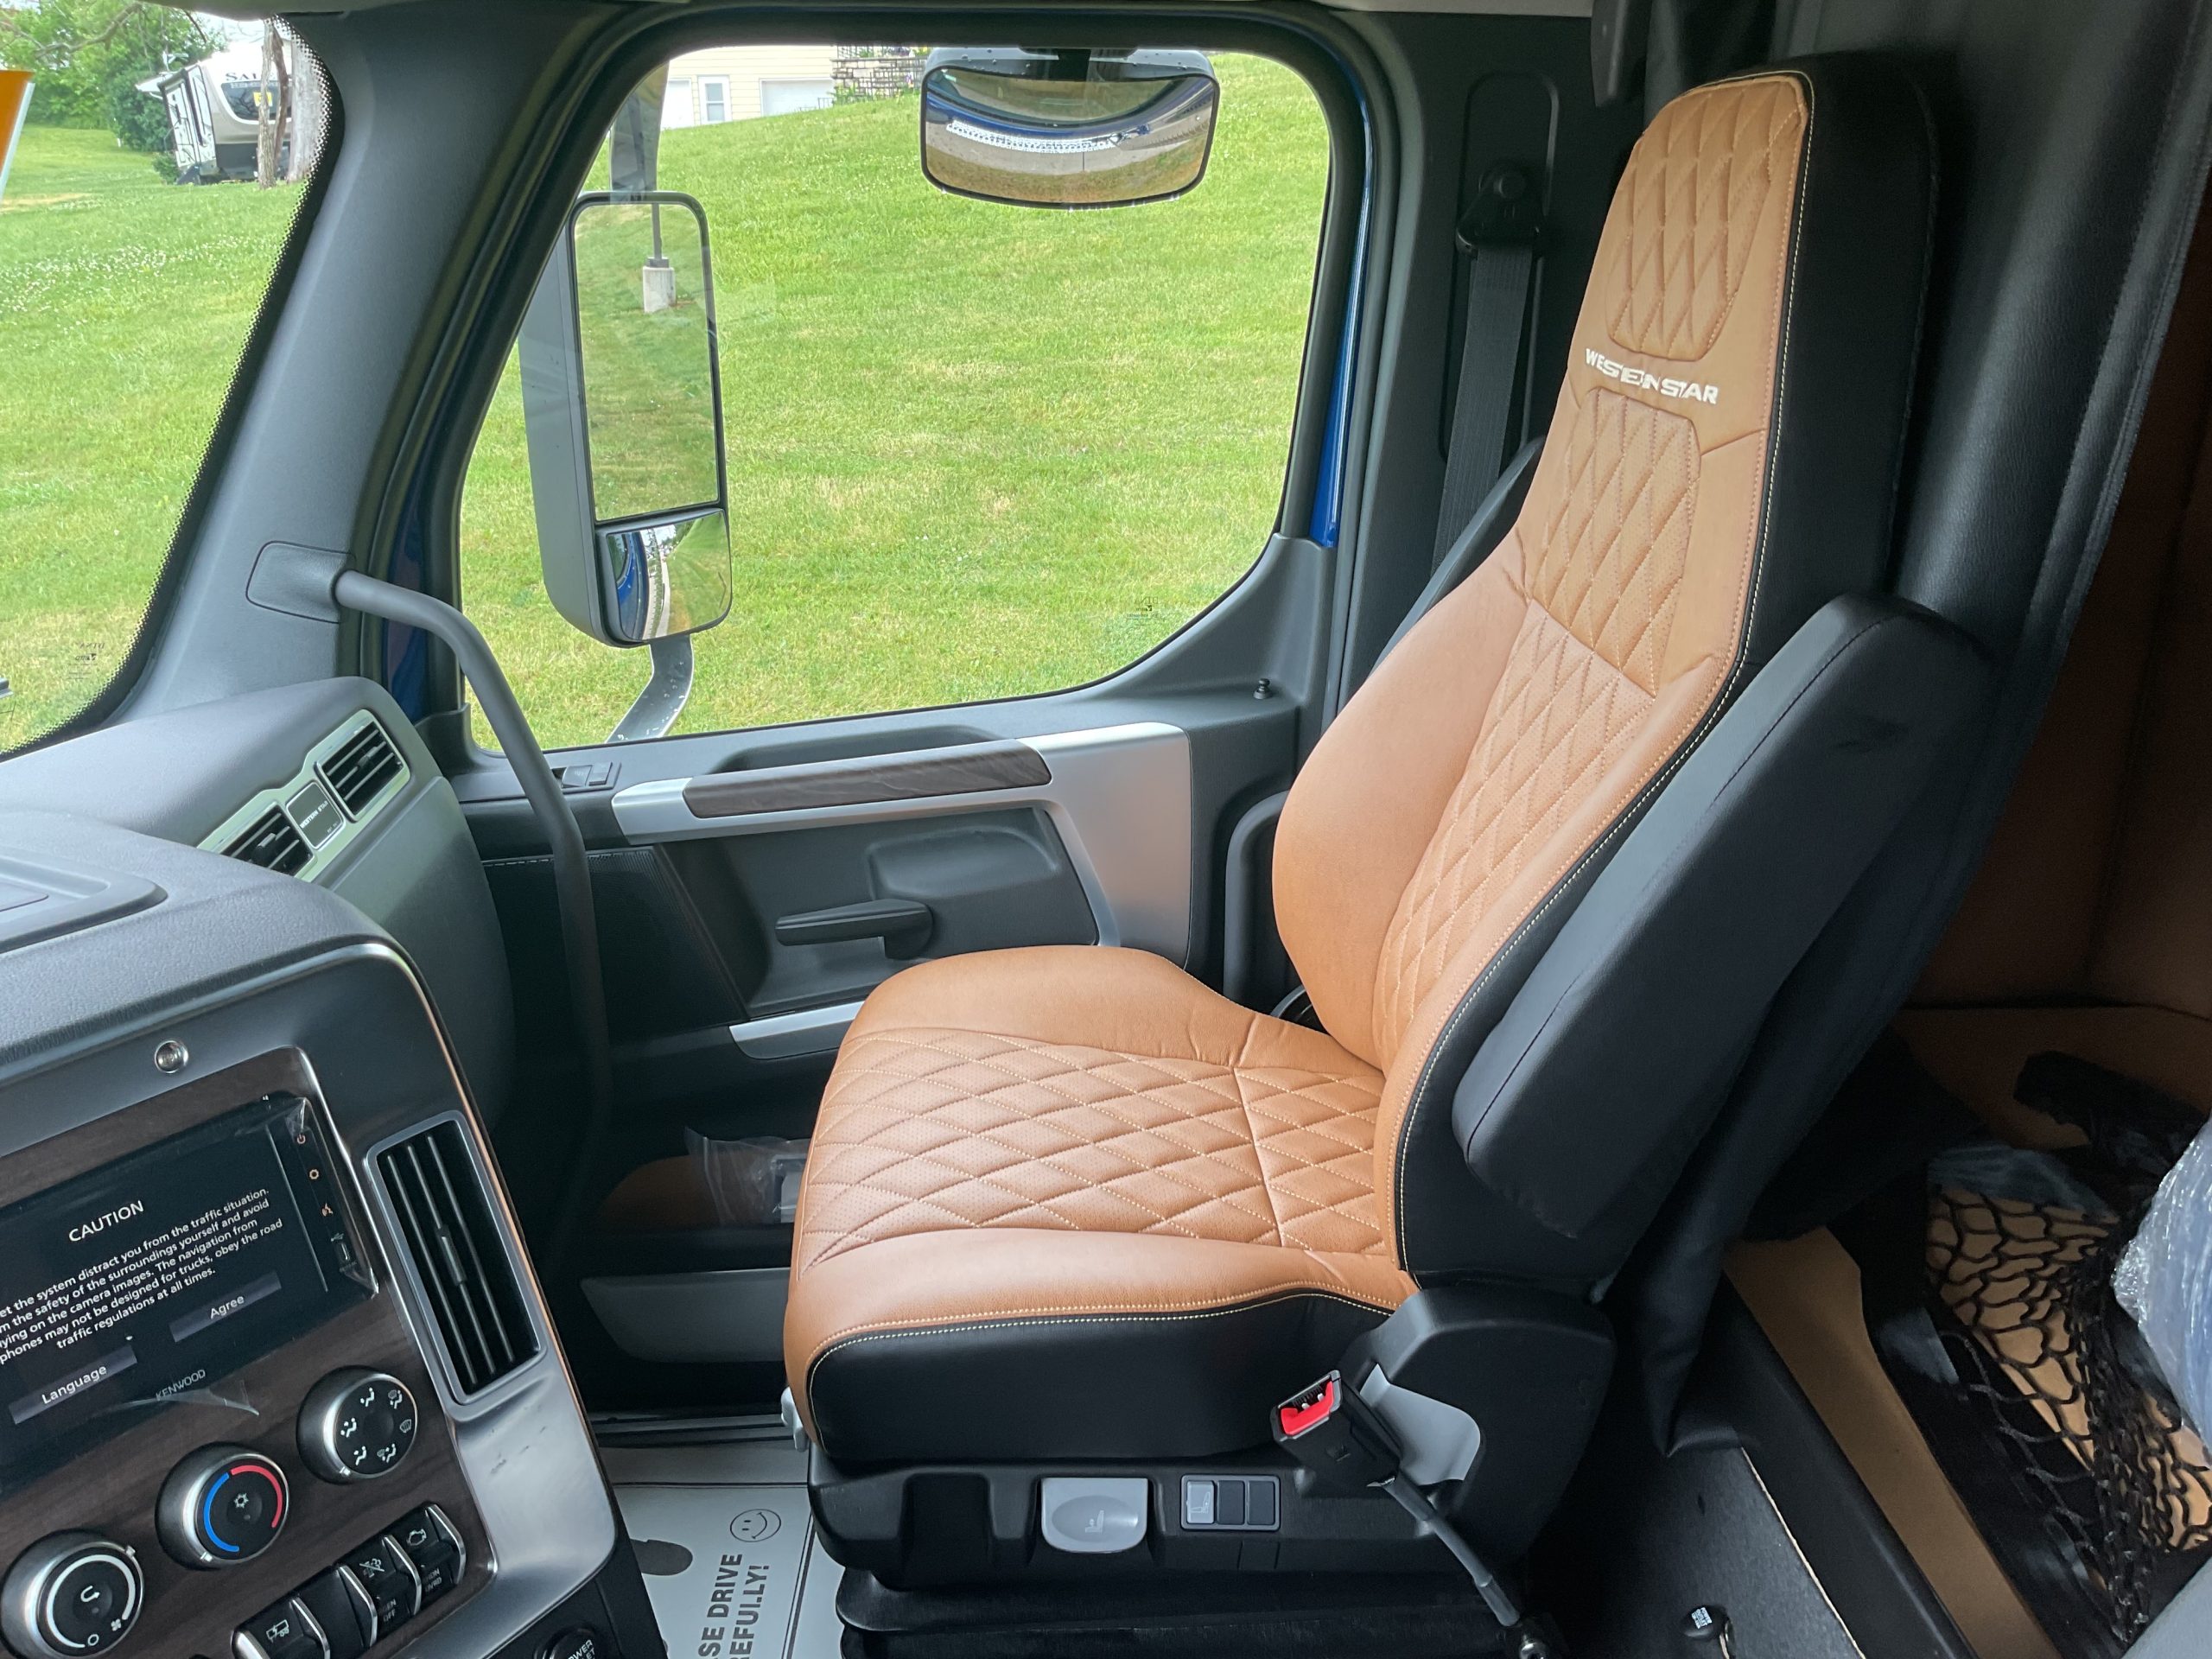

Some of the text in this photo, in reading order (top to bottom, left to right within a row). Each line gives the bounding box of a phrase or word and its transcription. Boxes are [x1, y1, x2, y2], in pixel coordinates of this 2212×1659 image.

[13, 1296, 35, 1311] the
[36, 1277, 76, 1301] system
[78, 1255, 120, 1281] distract
[121, 1246, 142, 1263] you
[143, 1234, 170, 1250] from
[171, 1224, 189, 1237] the
[190, 1210, 222, 1228] traffic
[223, 1188, 270, 1213] situation.
[69, 1199, 144, 1242] CAUTION
[0, 1217, 283, 1365] phones may not be designed for trucks, obey the road
[11, 1313, 33, 1326] the
[35, 1294, 70, 1316] safety
[72, 1284, 85, 1298] of
[86, 1277, 106, 1292] the
[108, 1243, 177, 1281] surroundings
[179, 1221, 219, 1249] yourself
[221, 1212, 241, 1227] and
[243, 1198, 270, 1217] avoid
[29, 1320, 46, 1333] on
[47, 1309, 68, 1324] the
[70, 1289, 111, 1313] camera
[111, 1269, 155, 1294] images.
[155, 1258, 176, 1272] The
[178, 1231, 232, 1262] navigation
[232, 1218, 258, 1236] from
[56, 1267, 216, 1349] traffic regulations at all times.
[211, 1296, 245, 1319] Agree
[41, 1365, 107, 1404] Language
[156, 1370, 206, 1402] KENWOOD
[707, 1554, 743, 1618] DRIVE
[729, 1565, 770, 1659] EFULLY!
